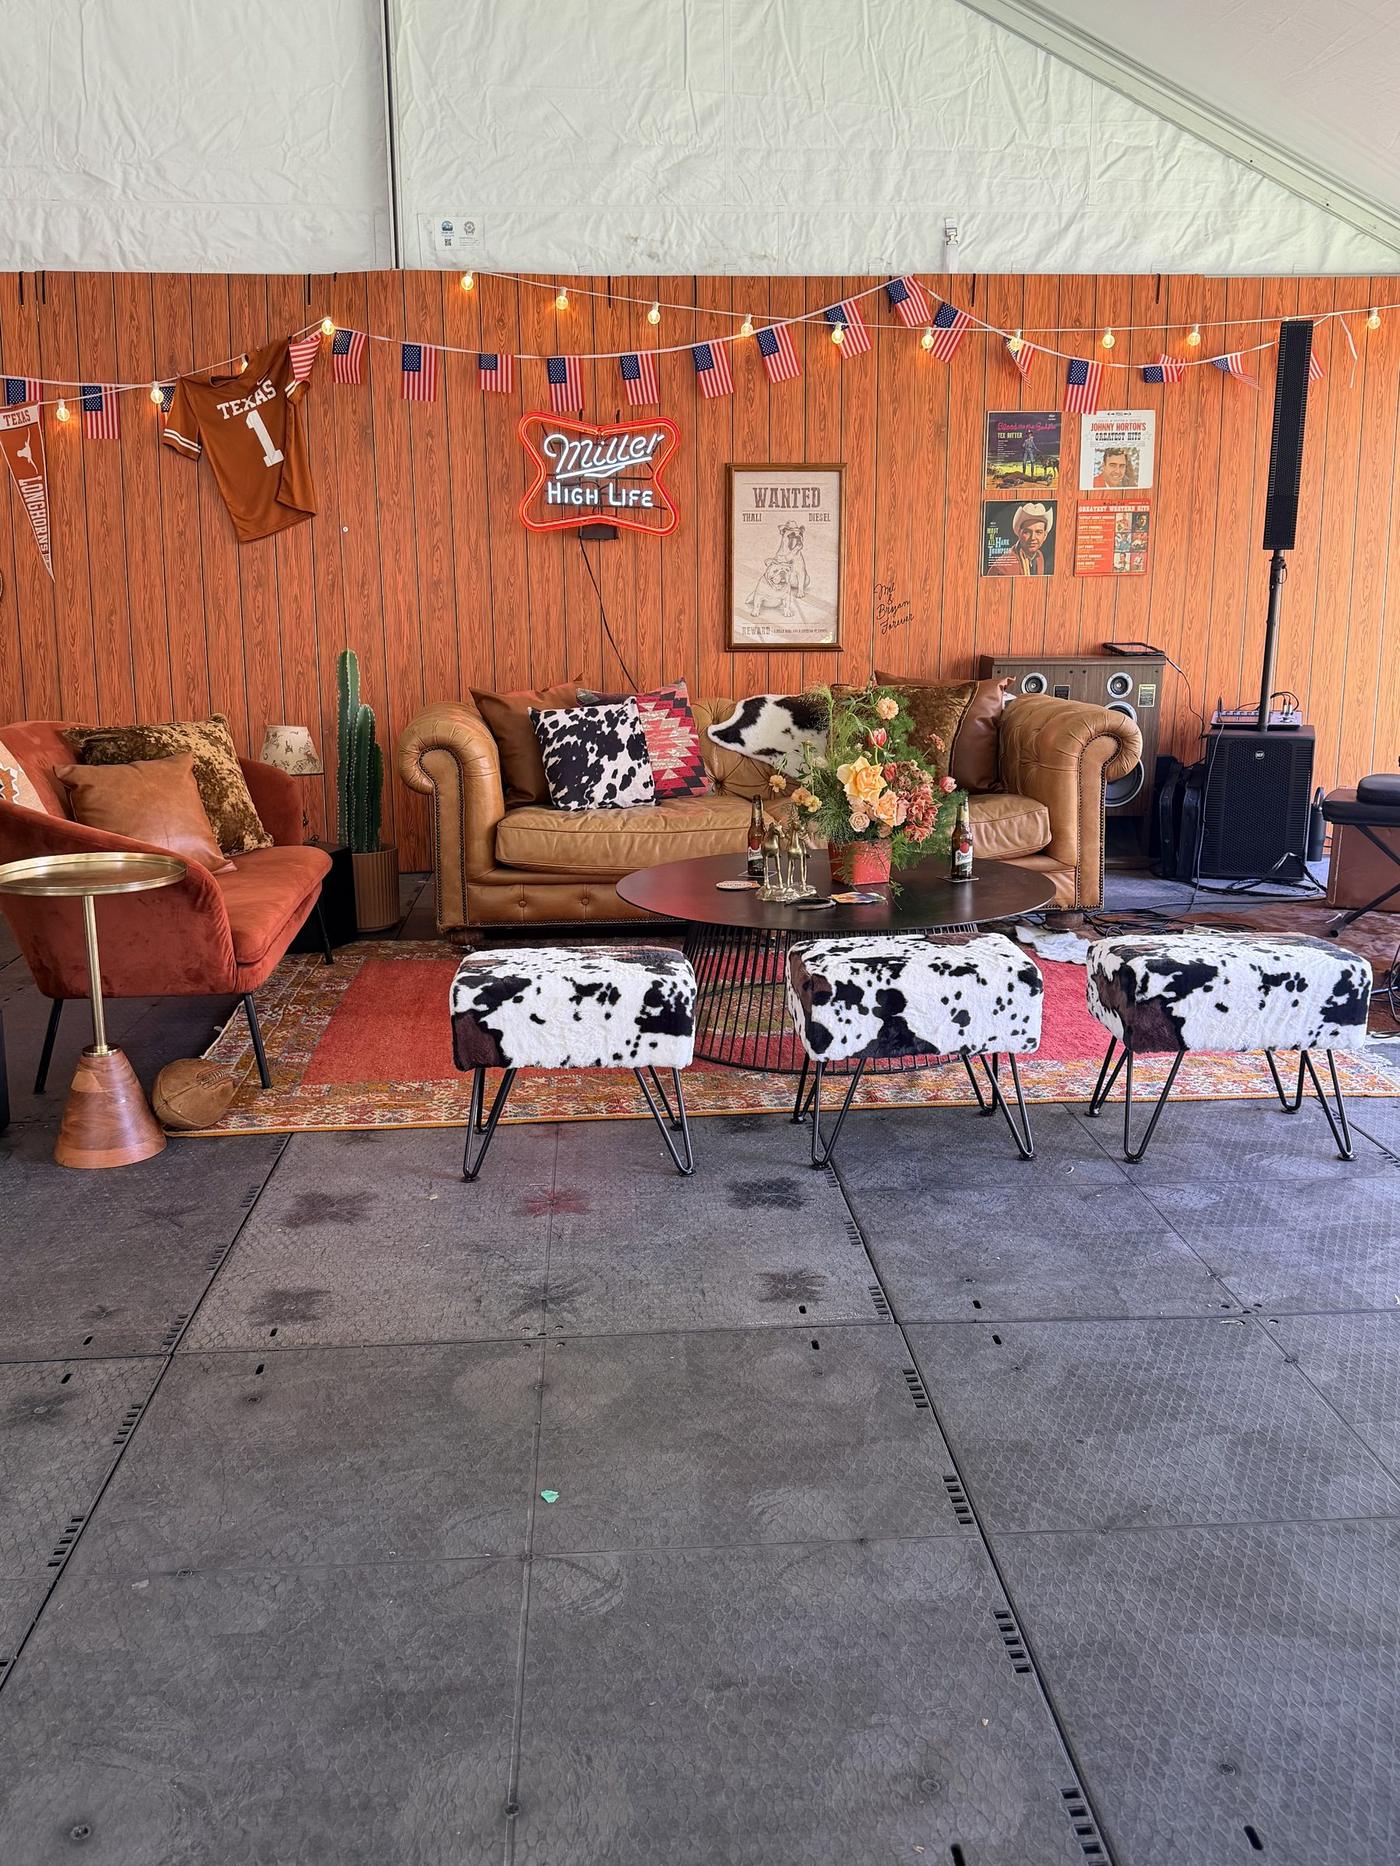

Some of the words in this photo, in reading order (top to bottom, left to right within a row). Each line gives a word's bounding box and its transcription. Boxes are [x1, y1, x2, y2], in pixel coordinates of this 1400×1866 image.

[216, 379, 277, 420] TEXAS
[3, 409, 31, 427] TEXAS
[1091, 422, 1115, 432] JOHNNY
[1116, 422, 1147, 431] HORTON'S
[245, 409, 284, 468] 1
[1095, 432, 1126, 441] GREATEST
[1127, 432, 1142, 441] HITS
[543, 432, 665, 474] Miller
[547, 481, 599, 505] HIGH
[608, 482, 654, 507] LIFE
[752, 487, 821, 509] WANTED
[18, 474, 49, 552] LONGHORNS
[742, 513, 763, 522] THALI
[808, 513, 832, 522] DIESEL
[876, 600, 911, 620] Bryan
